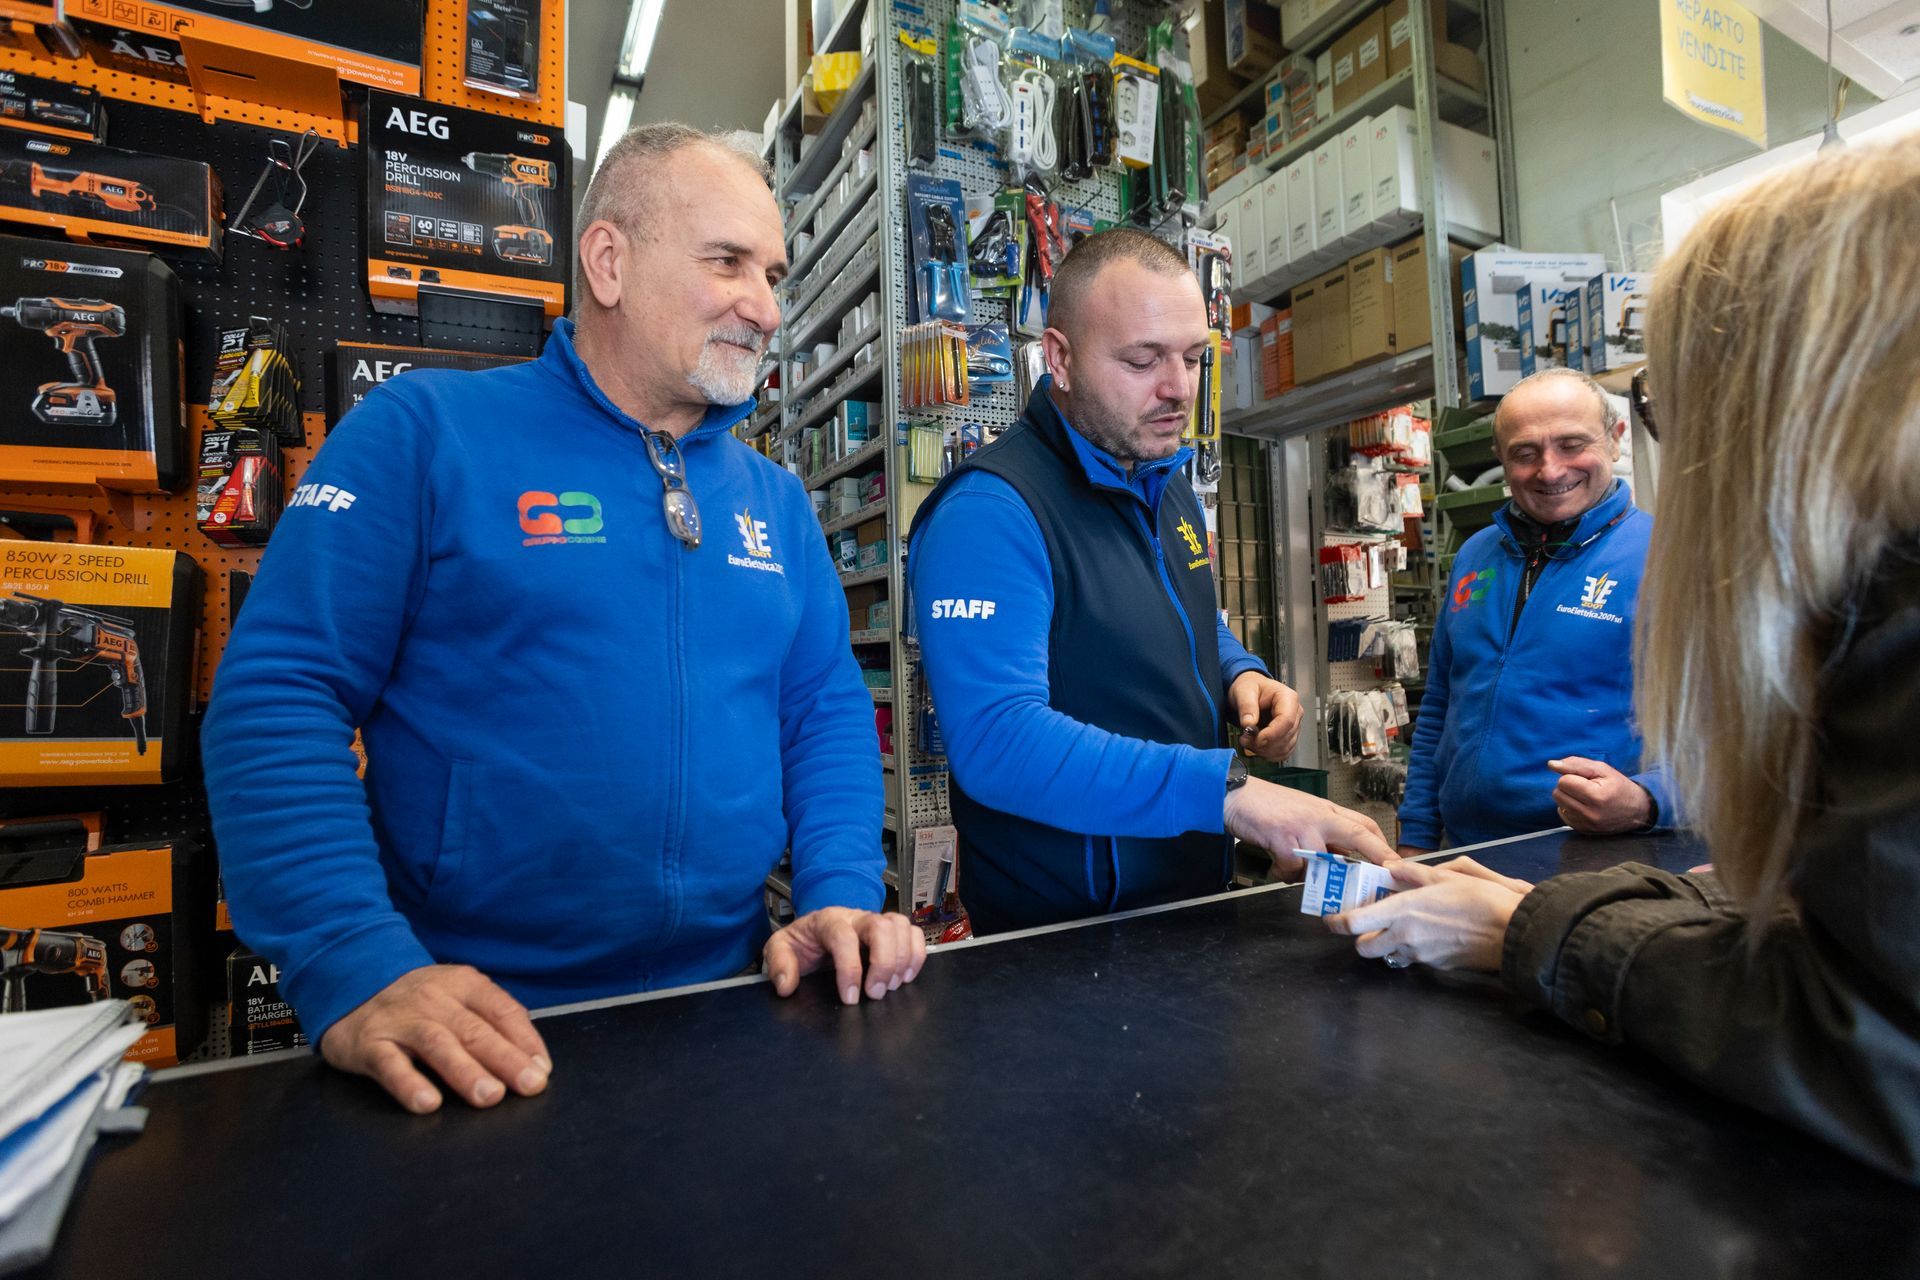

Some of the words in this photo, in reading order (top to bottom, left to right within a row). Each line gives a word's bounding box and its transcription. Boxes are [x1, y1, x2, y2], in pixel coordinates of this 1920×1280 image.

[385, 106, 450, 140] AEG
[385, 150, 408, 162] 18V
[385, 160, 461, 183] PERCUSSION
[519, 165, 538, 175] AEG
[385, 171, 421, 186] DRILL
[105, 185, 124, 195] AEG
[417, 220, 433, 230] 60
[72, 312, 95, 322] AEG
[205, 456, 223, 464] GEL
[287, 483, 357, 513] STAFF
[6, 550, 57, 564] 850W
[63, 554, 72, 566] 2
[78, 555, 125, 568] SPEED
[4, 567, 108, 583] PERCUSSION
[113, 573, 149, 586] DRILL
[931, 599, 996, 620] STAFF
[1581, 601, 1603, 610] 2001
[103, 637, 122, 648] AEG
[68, 888, 89, 898] 800
[92, 883, 128, 895] WATTS
[67, 897, 105, 909] COMBI
[108, 891, 155, 906] HAMMER
[87, 950, 102, 959] AEG
[247, 964, 282, 987] AE
[247, 997, 265, 1006] 18V
[247, 1009, 292, 1022] CHARGER
